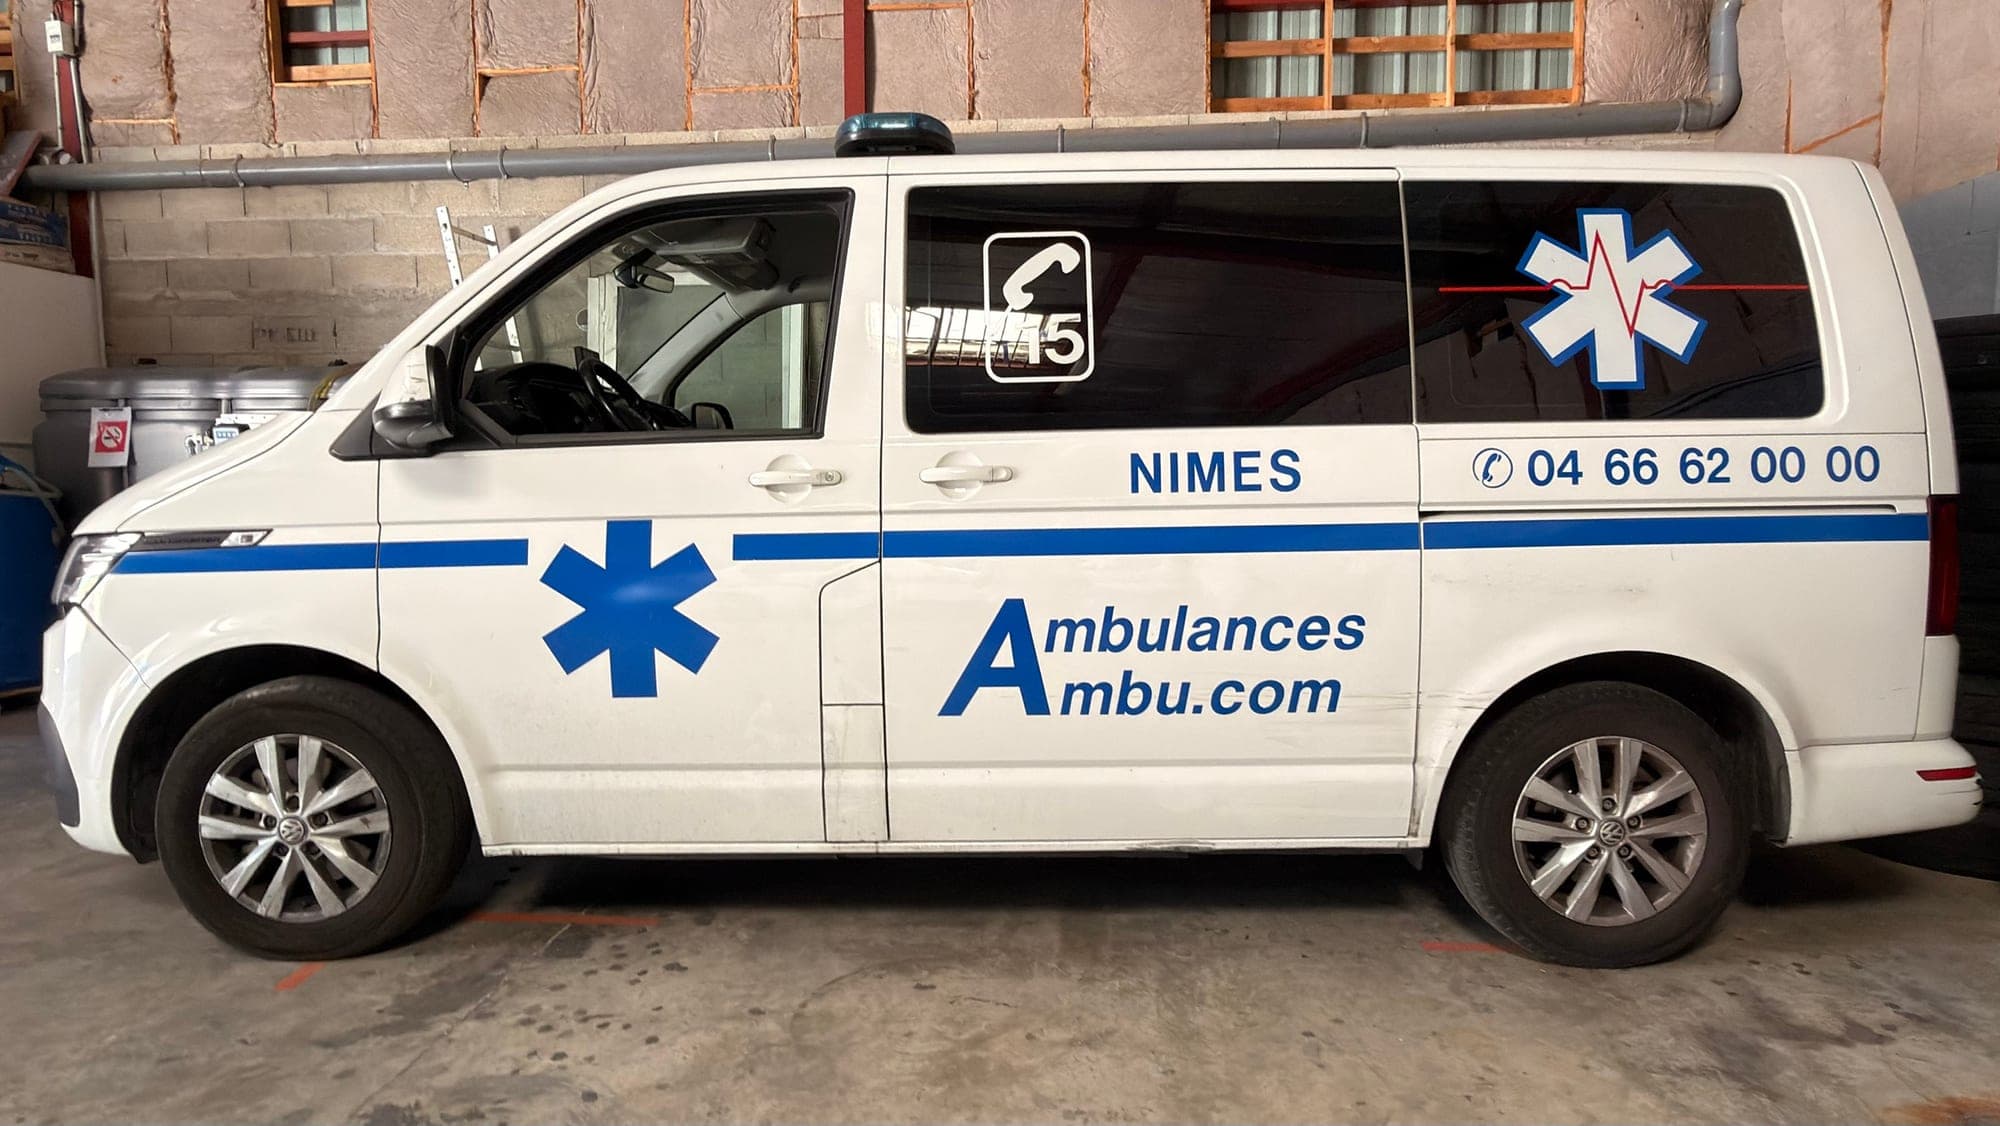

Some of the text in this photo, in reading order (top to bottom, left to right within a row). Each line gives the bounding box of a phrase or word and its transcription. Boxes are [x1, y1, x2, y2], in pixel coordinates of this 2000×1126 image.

[1017, 312, 1085, 365] 15
[1129, 449, 1302, 494] NIMES
[1527, 446, 1880, 486] 04 66 62 00 00
[938, 598, 1366, 717] Ambulances
